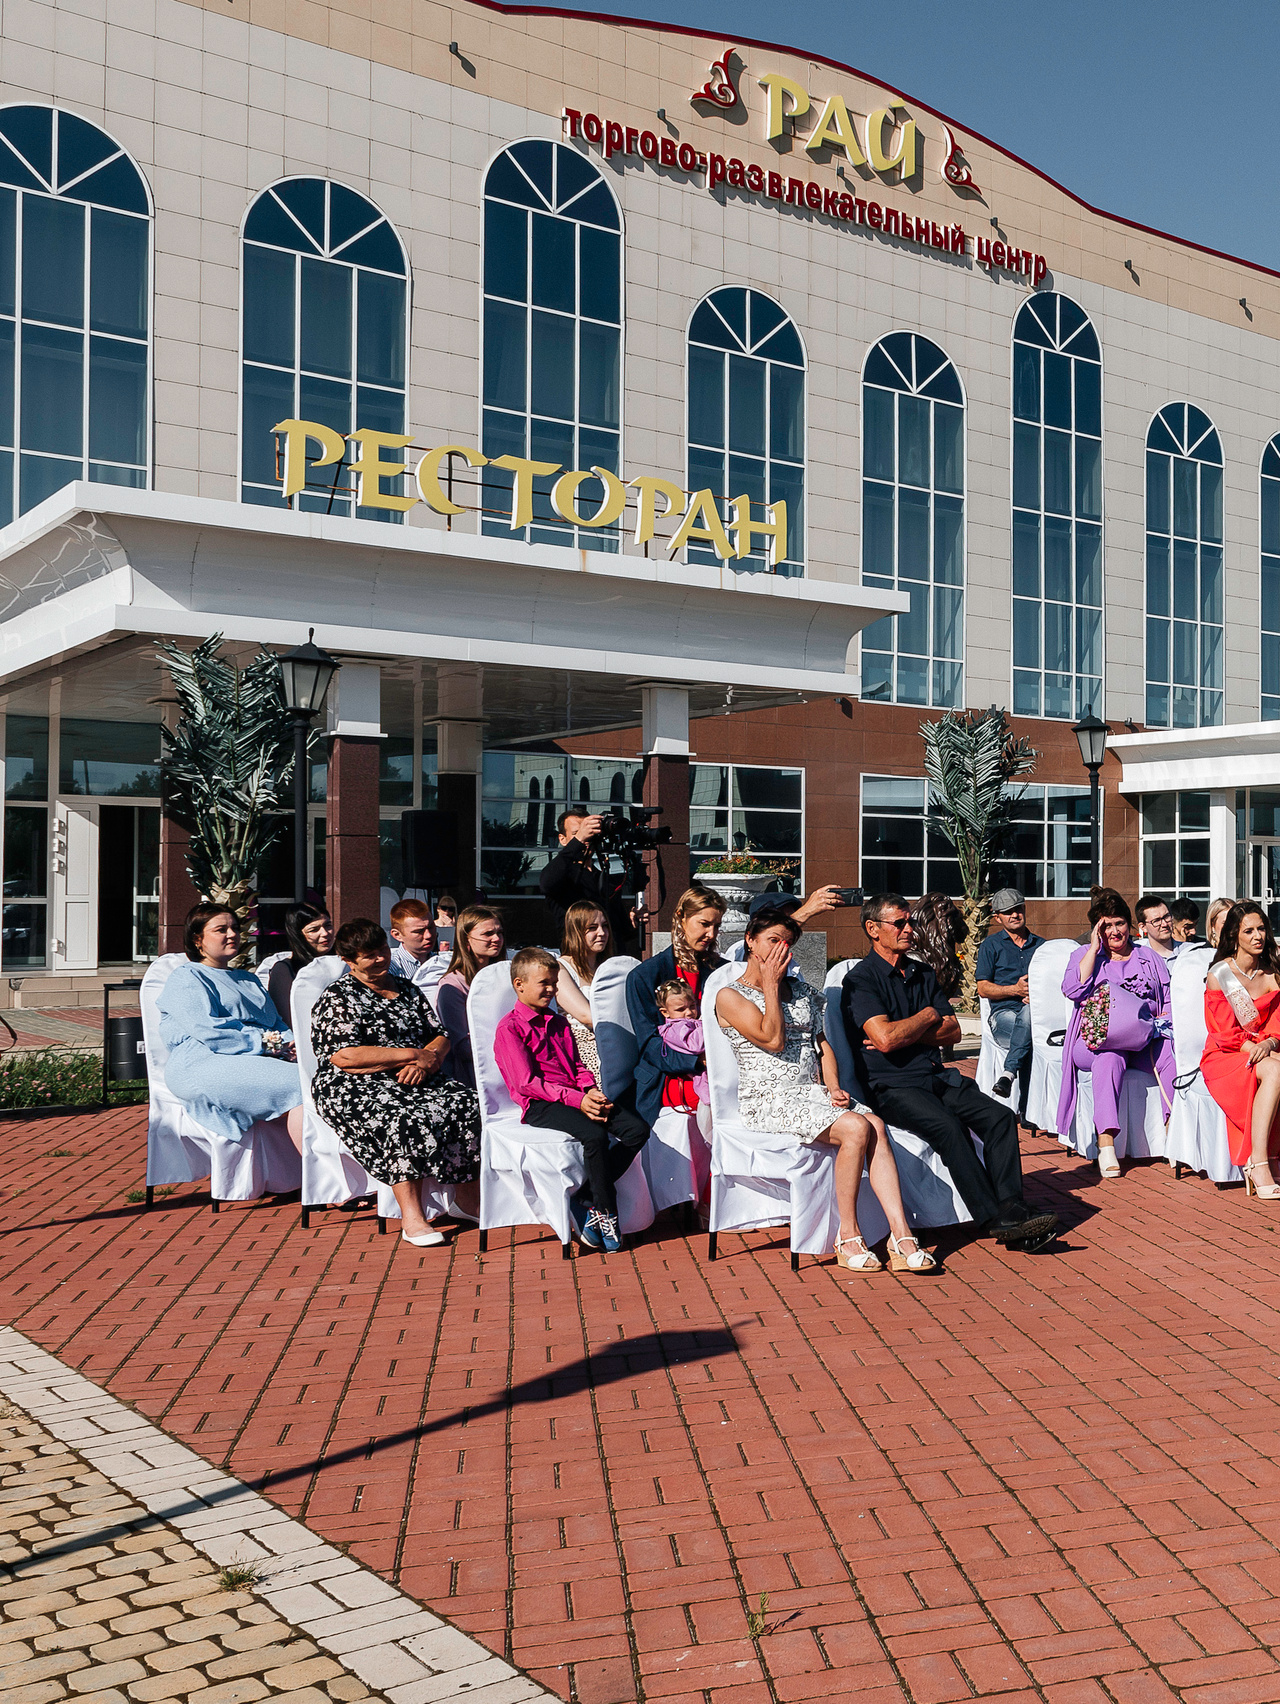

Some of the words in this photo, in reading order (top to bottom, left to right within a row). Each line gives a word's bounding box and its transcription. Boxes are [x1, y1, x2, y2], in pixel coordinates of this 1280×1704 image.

[757, 73, 916, 180] РАЙ
[974, 235, 1047, 287] центр
[270, 418, 788, 566] РЕСТОРАН
